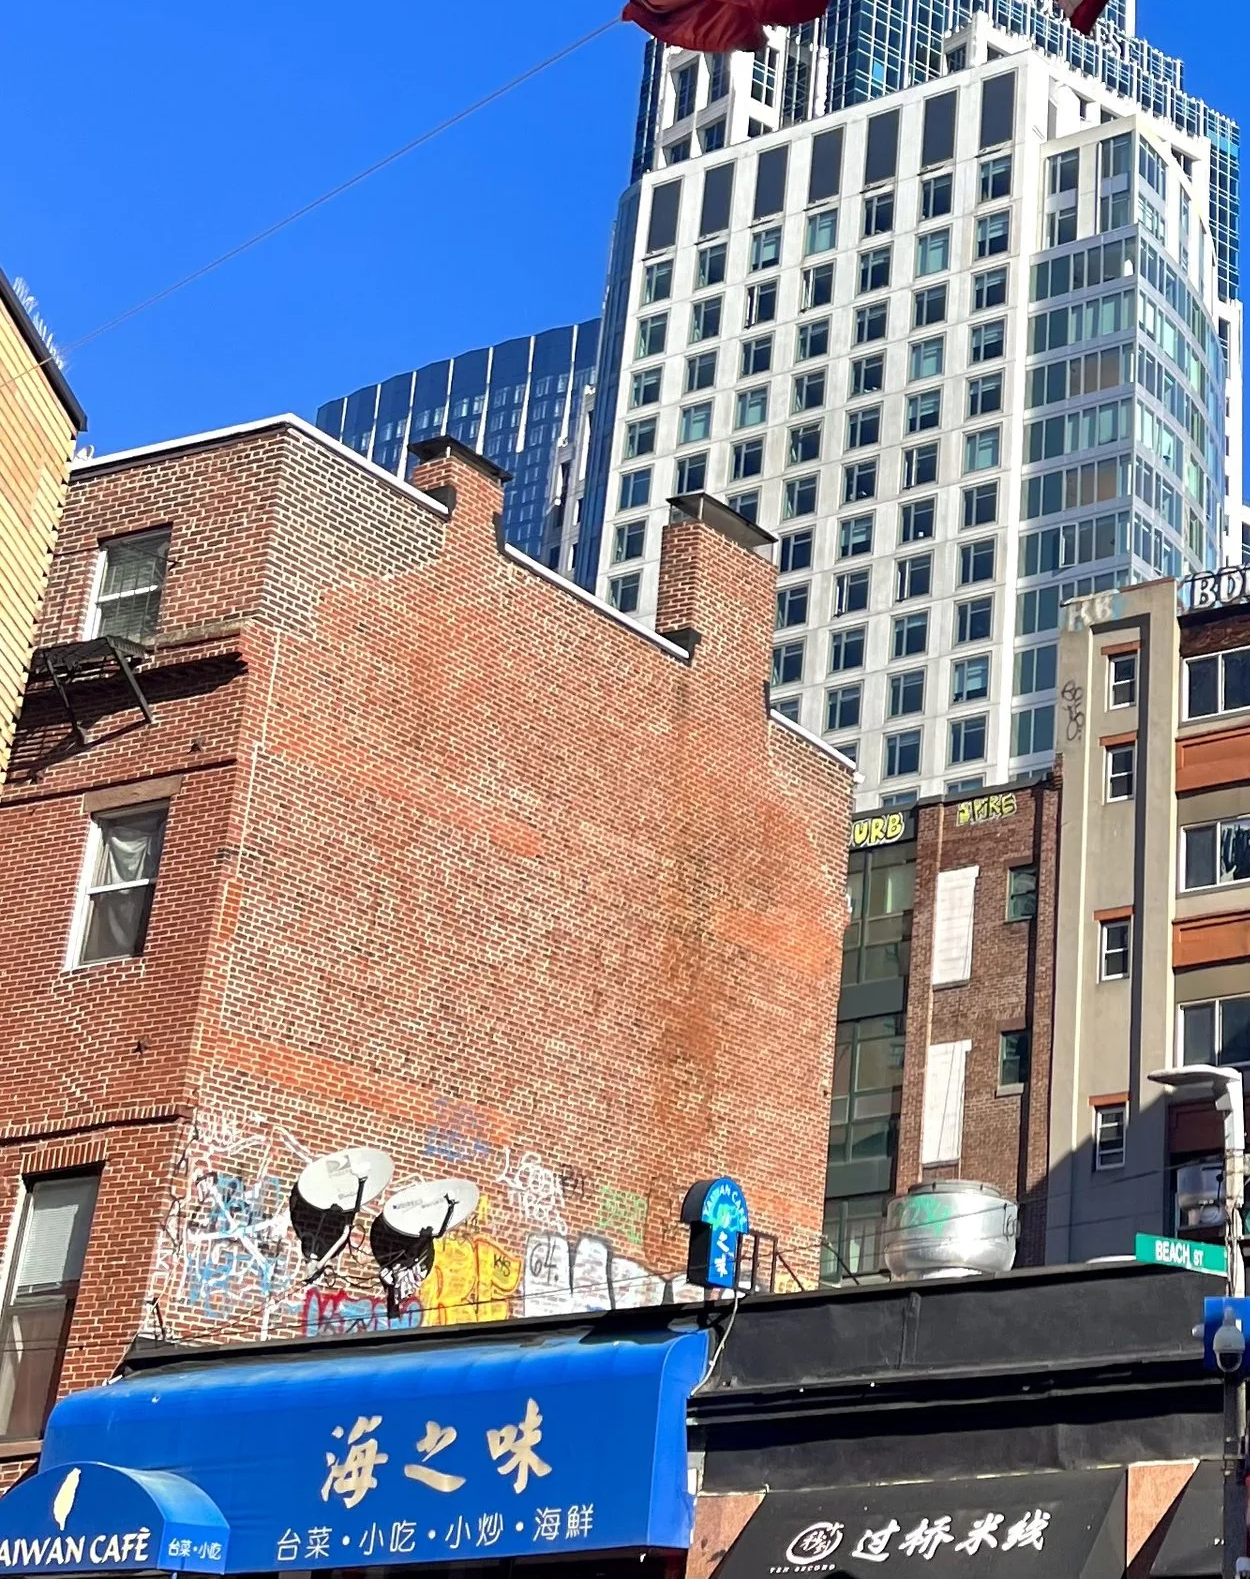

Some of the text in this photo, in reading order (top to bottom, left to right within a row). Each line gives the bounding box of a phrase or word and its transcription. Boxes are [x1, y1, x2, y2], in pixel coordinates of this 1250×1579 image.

[1154, 1239, 1205, 1267] BEACH ST
[321, 1397, 552, 1509] 海之味
[0, 1535, 85, 1567] AIWAN
[851, 1509, 1051, 1563] 过桥米线
